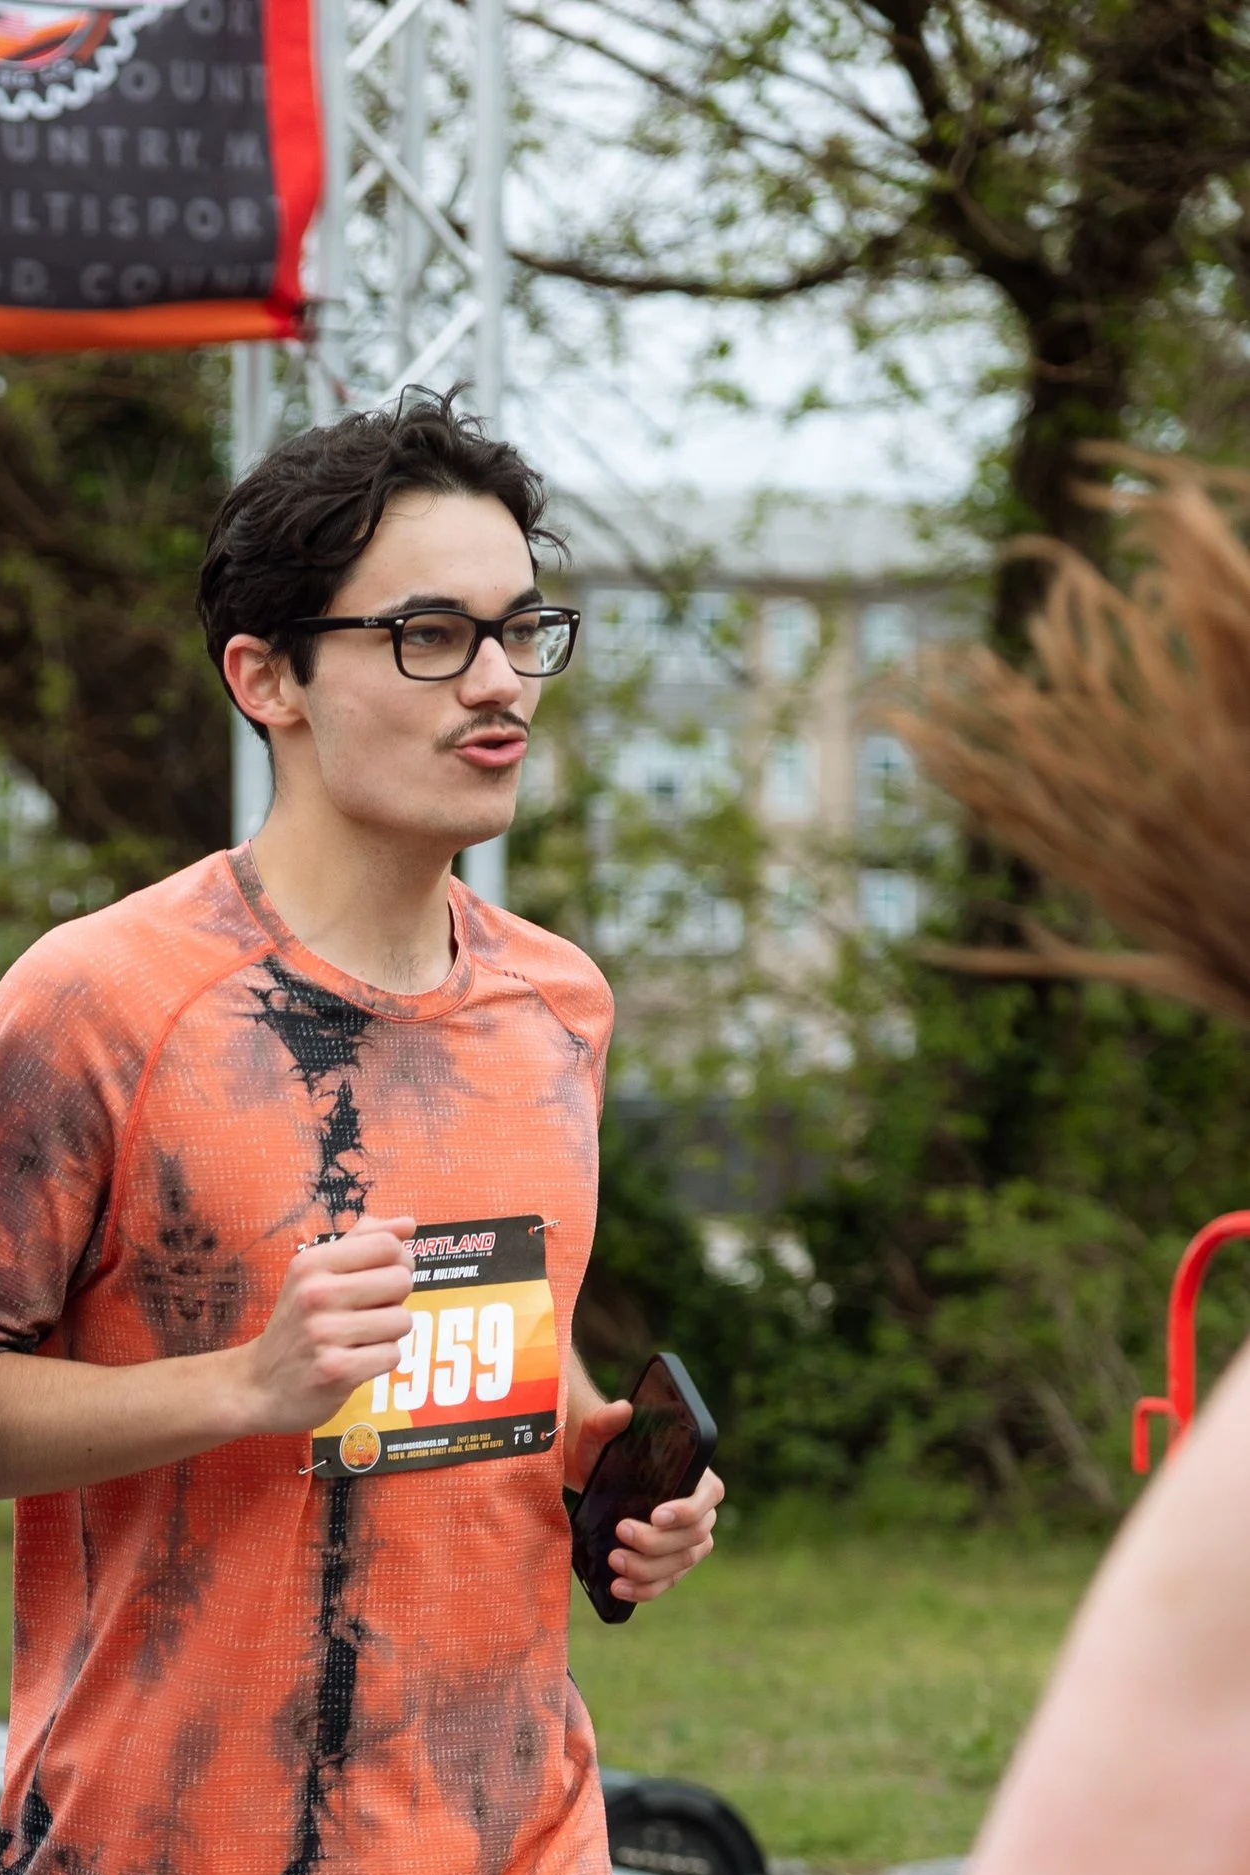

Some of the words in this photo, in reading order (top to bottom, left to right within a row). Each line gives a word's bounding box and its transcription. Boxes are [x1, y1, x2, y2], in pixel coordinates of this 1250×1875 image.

[402, 1232, 496, 1257] EARTLAND
[411, 1270, 431, 1283] NTRY.
[433, 1265, 479, 1281] MULTISPORT.
